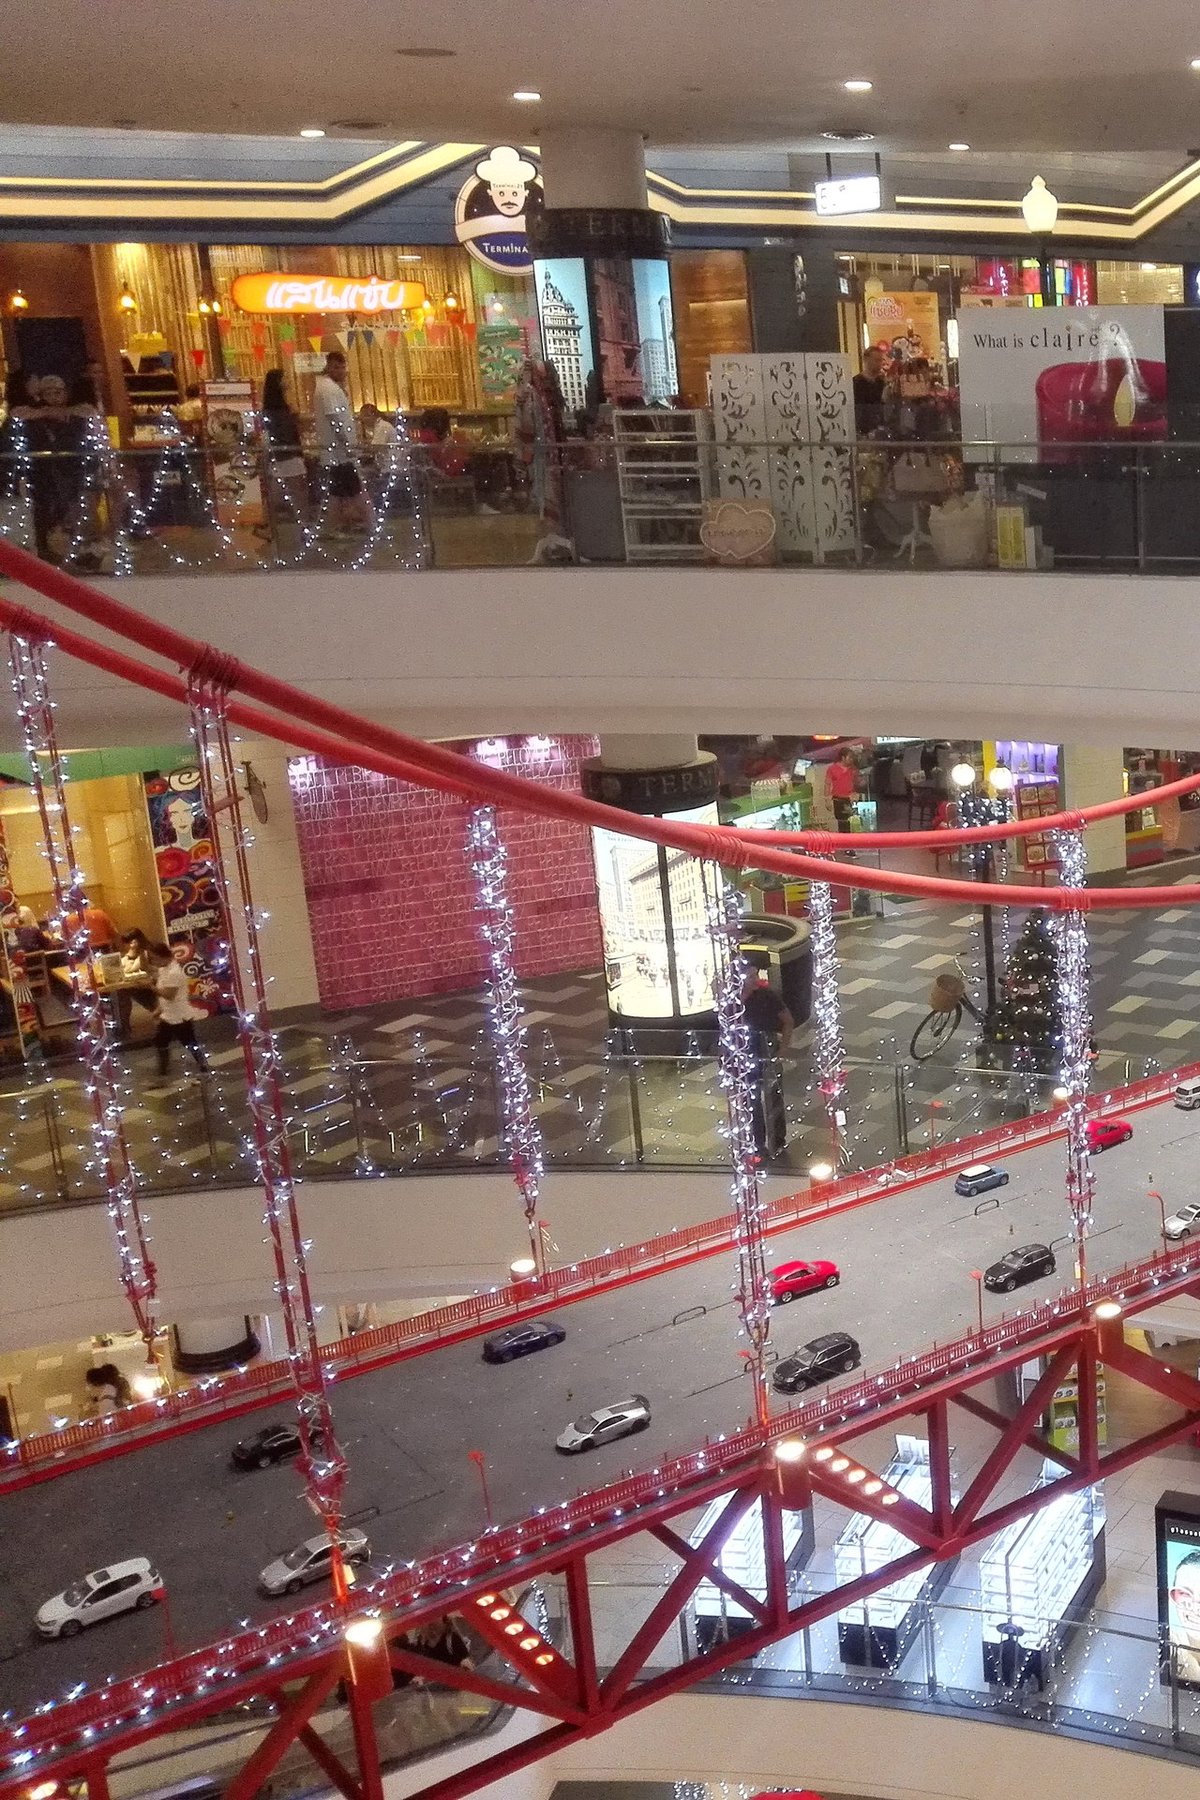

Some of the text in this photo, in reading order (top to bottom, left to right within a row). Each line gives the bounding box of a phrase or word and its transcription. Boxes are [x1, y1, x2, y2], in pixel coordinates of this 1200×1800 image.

[482, 240, 529, 255] TERMINA
[973, 334, 1008, 349] What
[1013, 333, 1024, 348] is
[1030, 325, 1099, 351] claire
